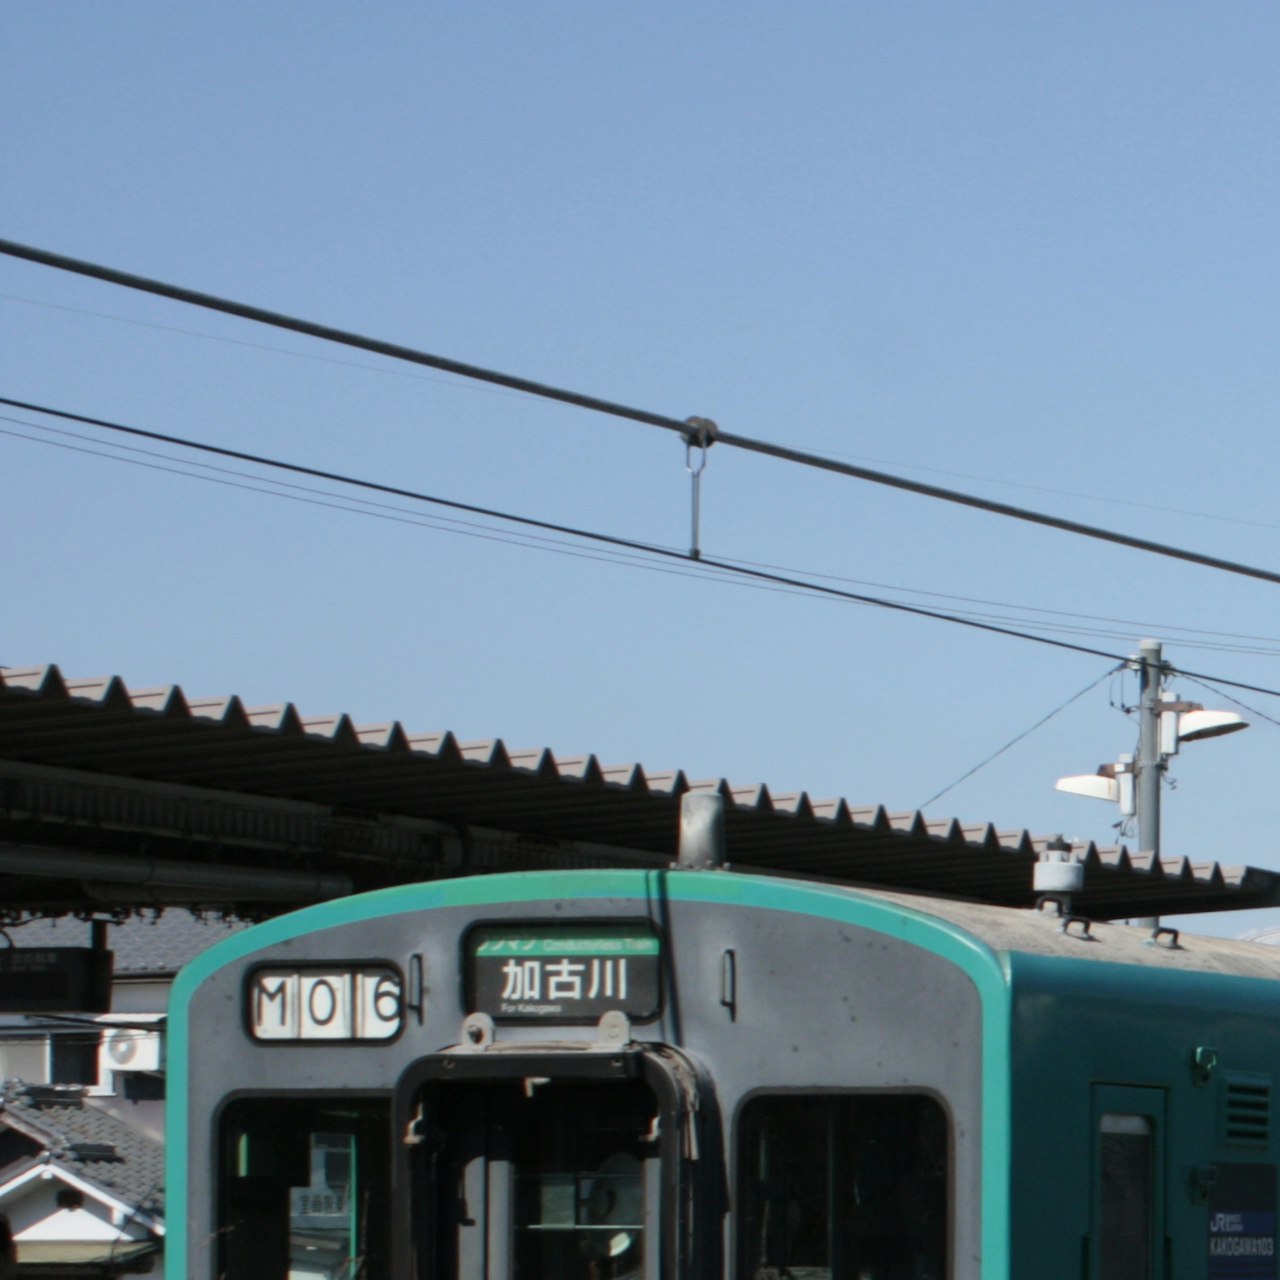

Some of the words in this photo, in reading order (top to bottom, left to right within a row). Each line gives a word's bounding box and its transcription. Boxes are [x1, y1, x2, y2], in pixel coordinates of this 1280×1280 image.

[502, 959, 627, 1000] 加古川
[501, 1002, 517, 1013] For
[518, 1002, 562, 1016] Kakogawa
[1210, 1236, 1274, 1256] KAKOGAWA103
